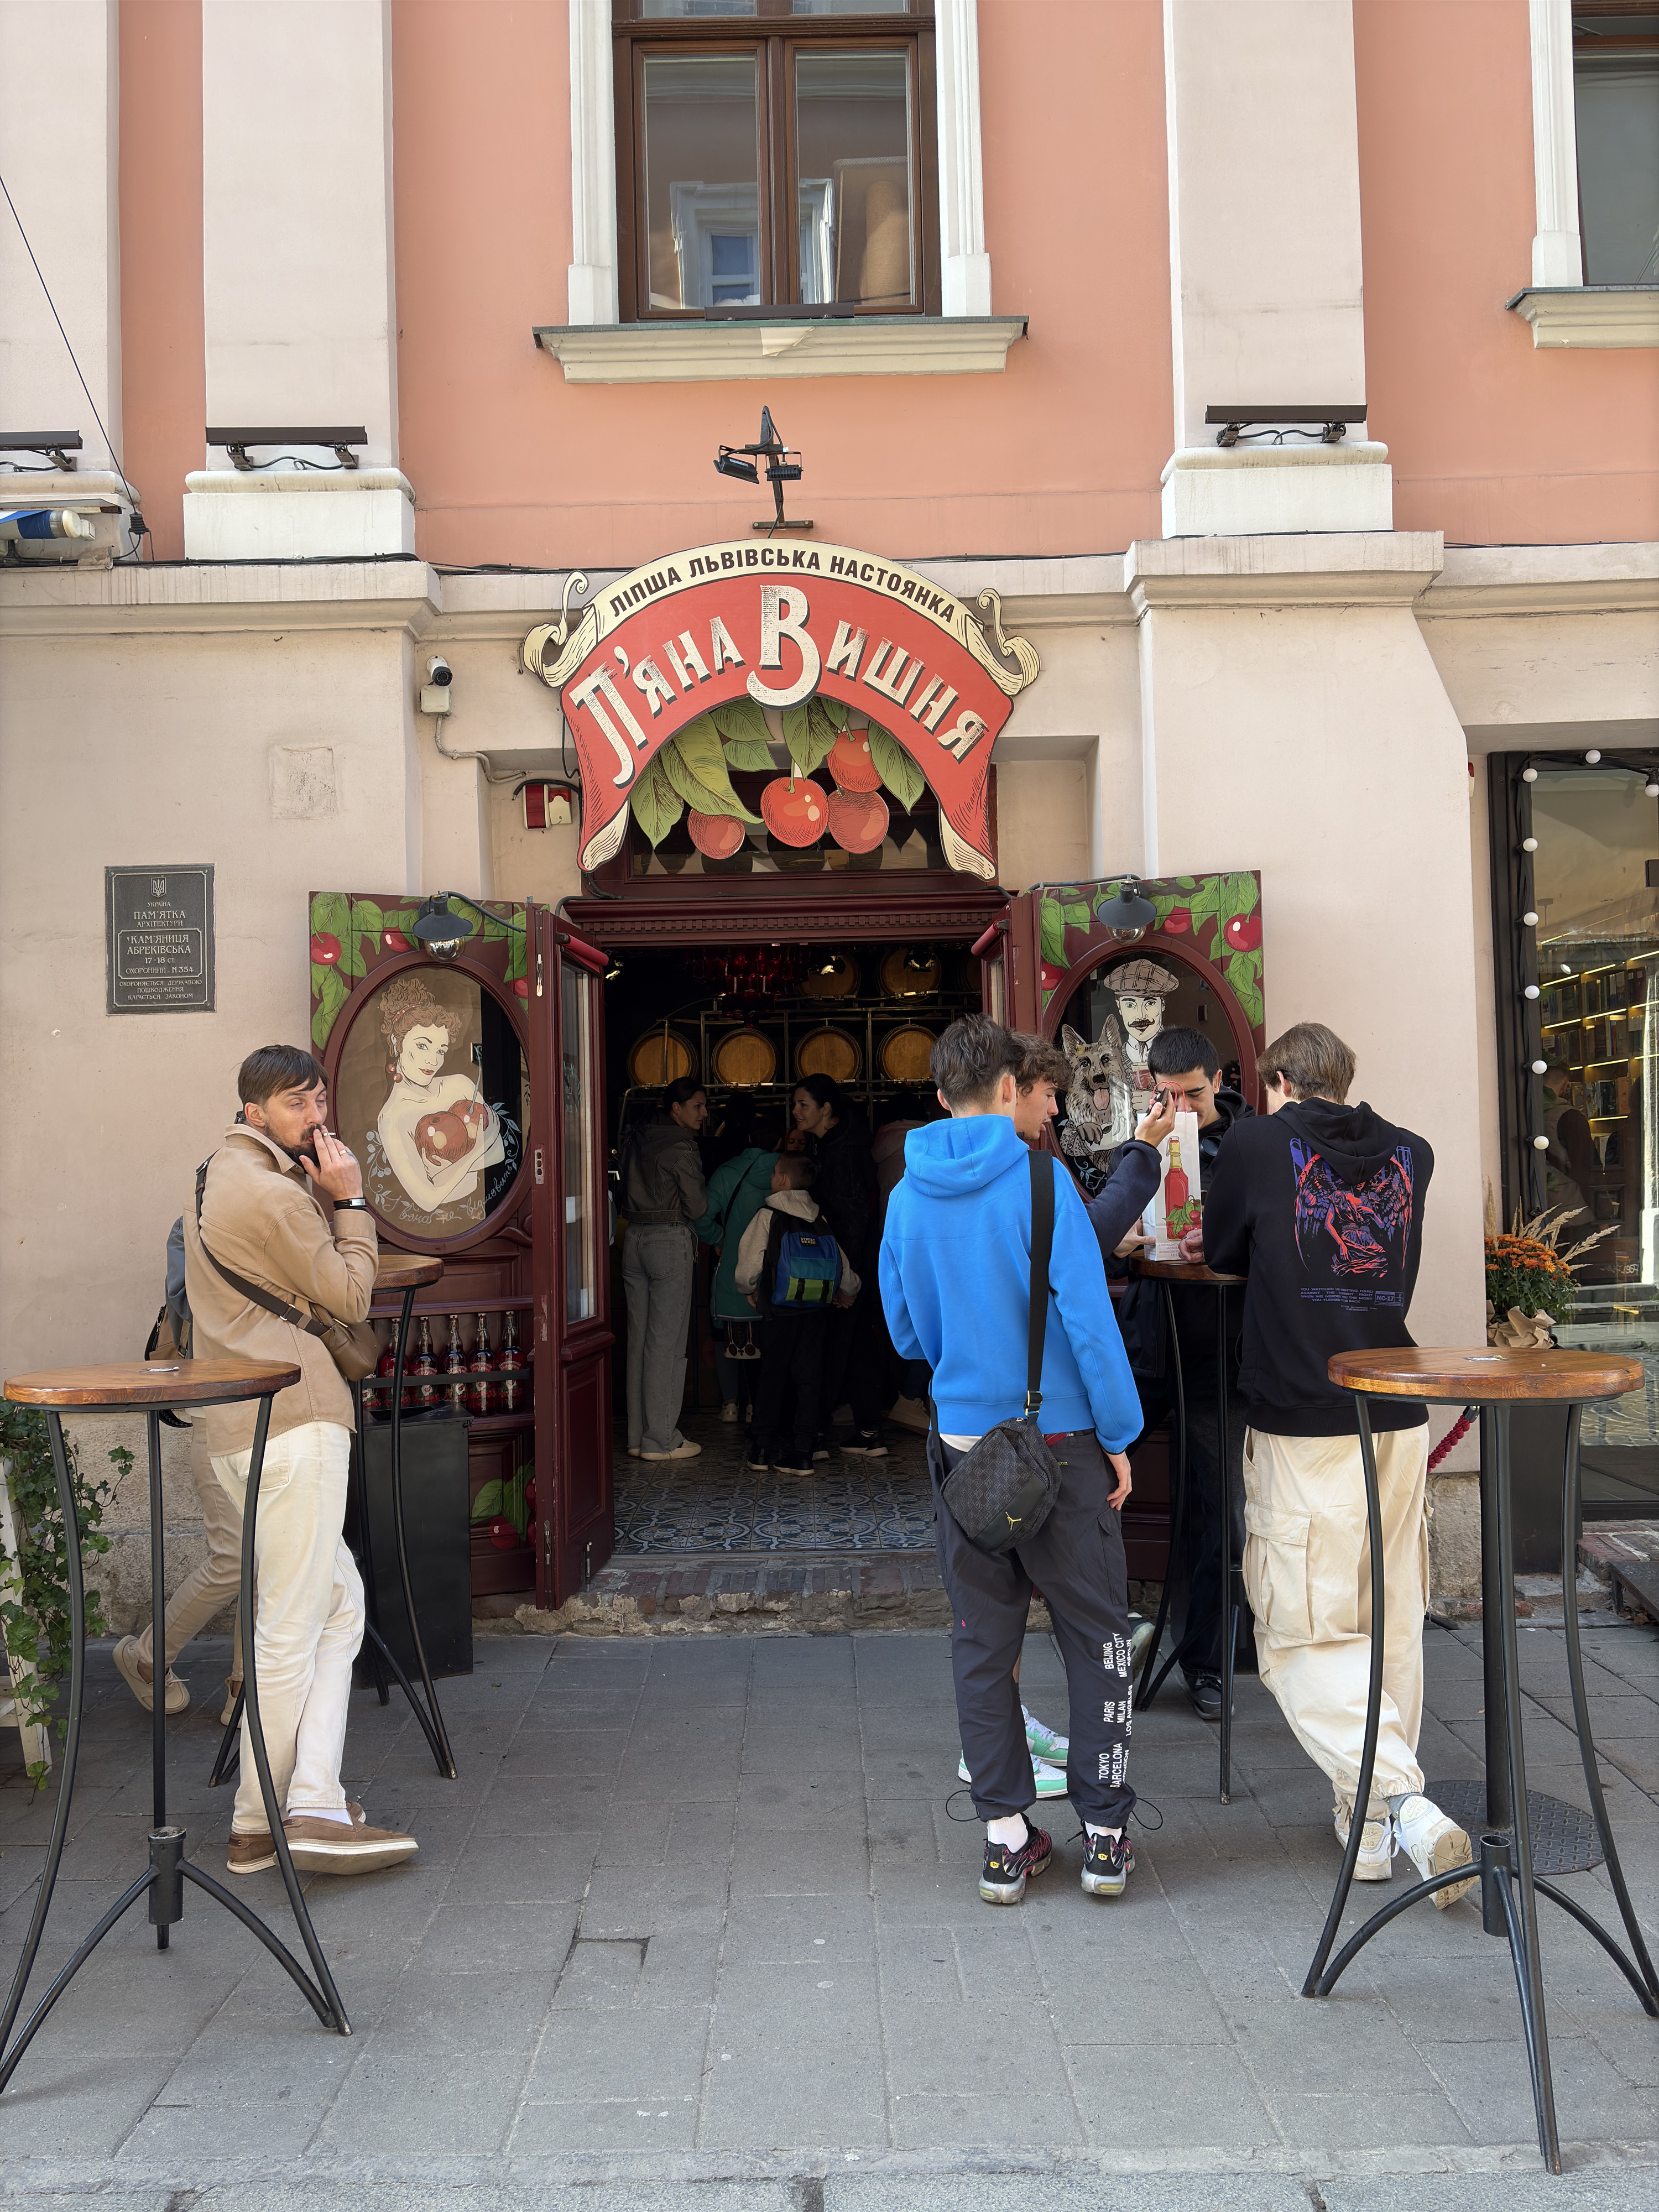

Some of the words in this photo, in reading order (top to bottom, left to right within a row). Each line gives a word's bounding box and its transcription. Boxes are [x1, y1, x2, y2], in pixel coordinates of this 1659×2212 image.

[609, 568, 683, 618] ЛІПША
[689, 548, 821, 579] ЛЬВІВСЬКА
[830, 556, 955, 623] НАСТОЯНКА
[133, 911, 186, 920] ПАМ'ЯТКА
[127, 945, 191, 954] АБРЕКІВСЬКА
[1112, 1632, 1125, 1648] CITY
[1103, 1642, 1115, 1670] BEIJING
[1117, 1649, 1128, 1678] MEXICO
[1103, 1700, 1115, 1723] PARIS
[1117, 1700, 1126, 1723] MILAN
[1099, 1753, 1110, 1780] TOKYO
[1110, 1743, 1123, 1788] BARCELONA
